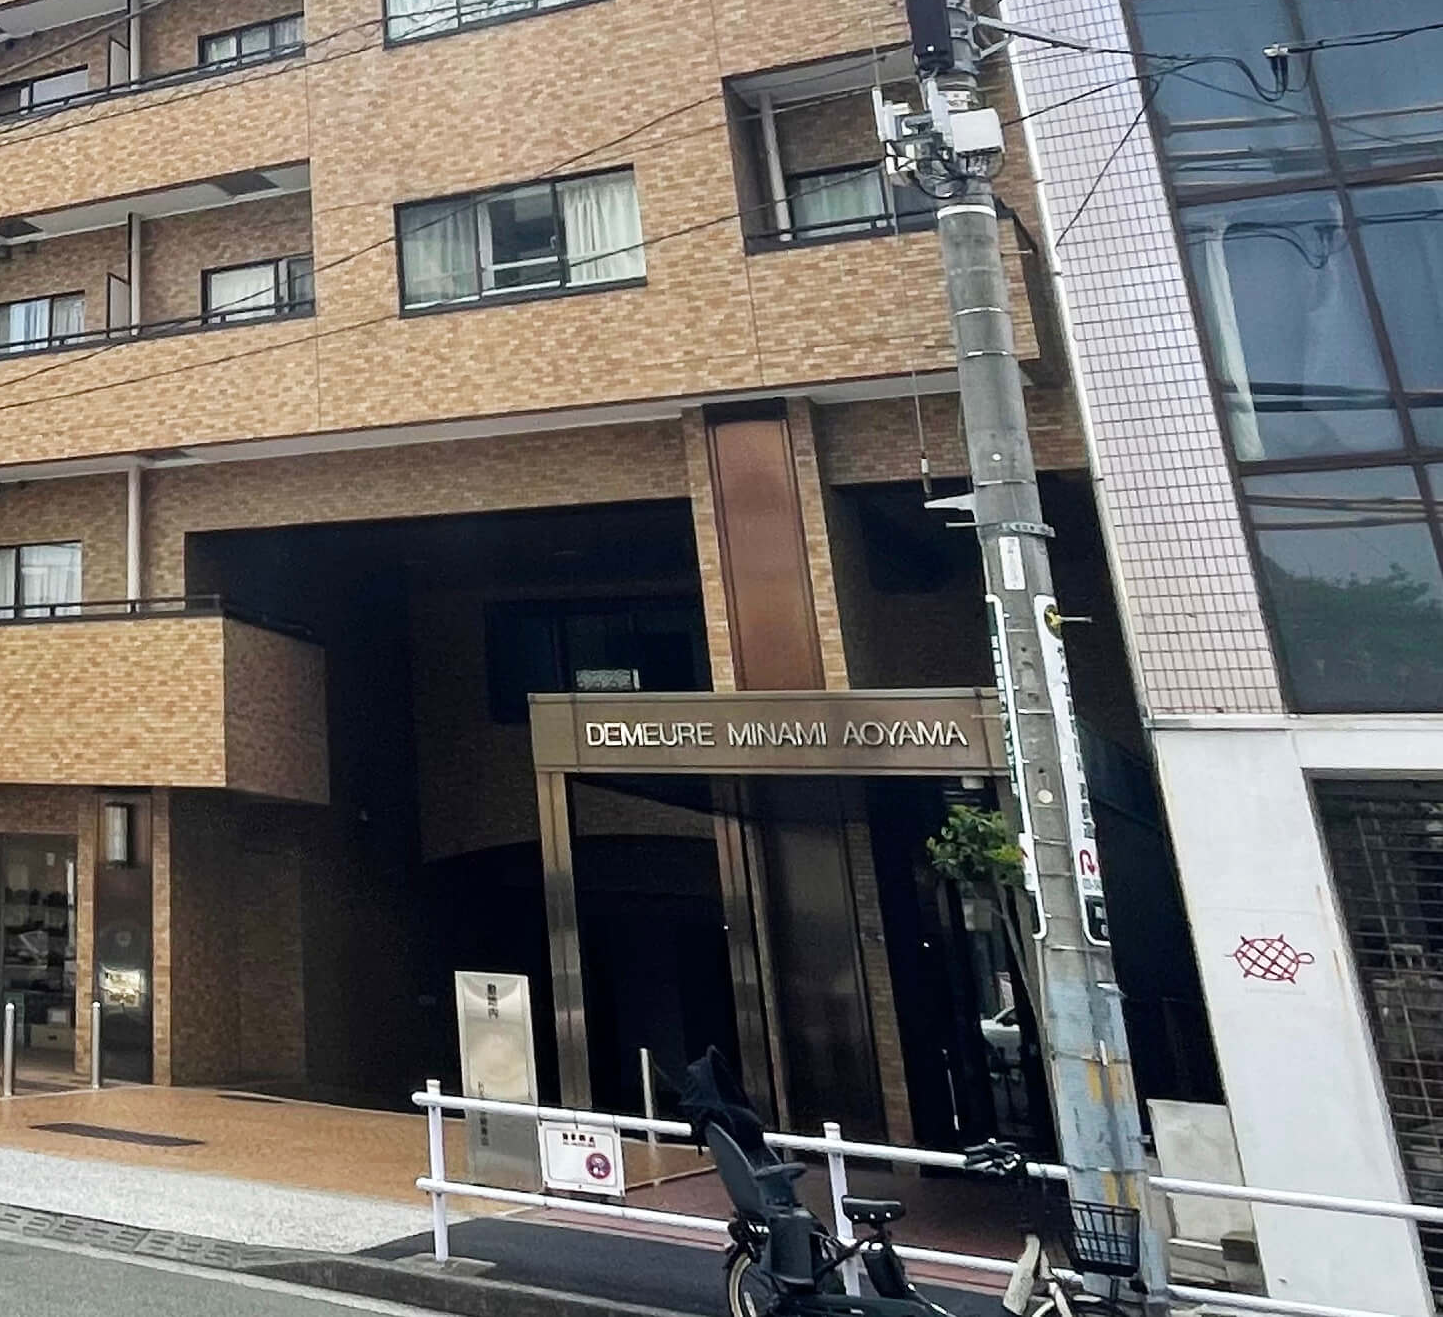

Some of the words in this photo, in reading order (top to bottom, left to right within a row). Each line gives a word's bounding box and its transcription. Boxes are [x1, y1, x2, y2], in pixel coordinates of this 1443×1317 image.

[585, 721, 715, 747] DEMEURE
[726, 721, 828, 746] MINAMI
[843, 721, 968, 747] AOYAMA
